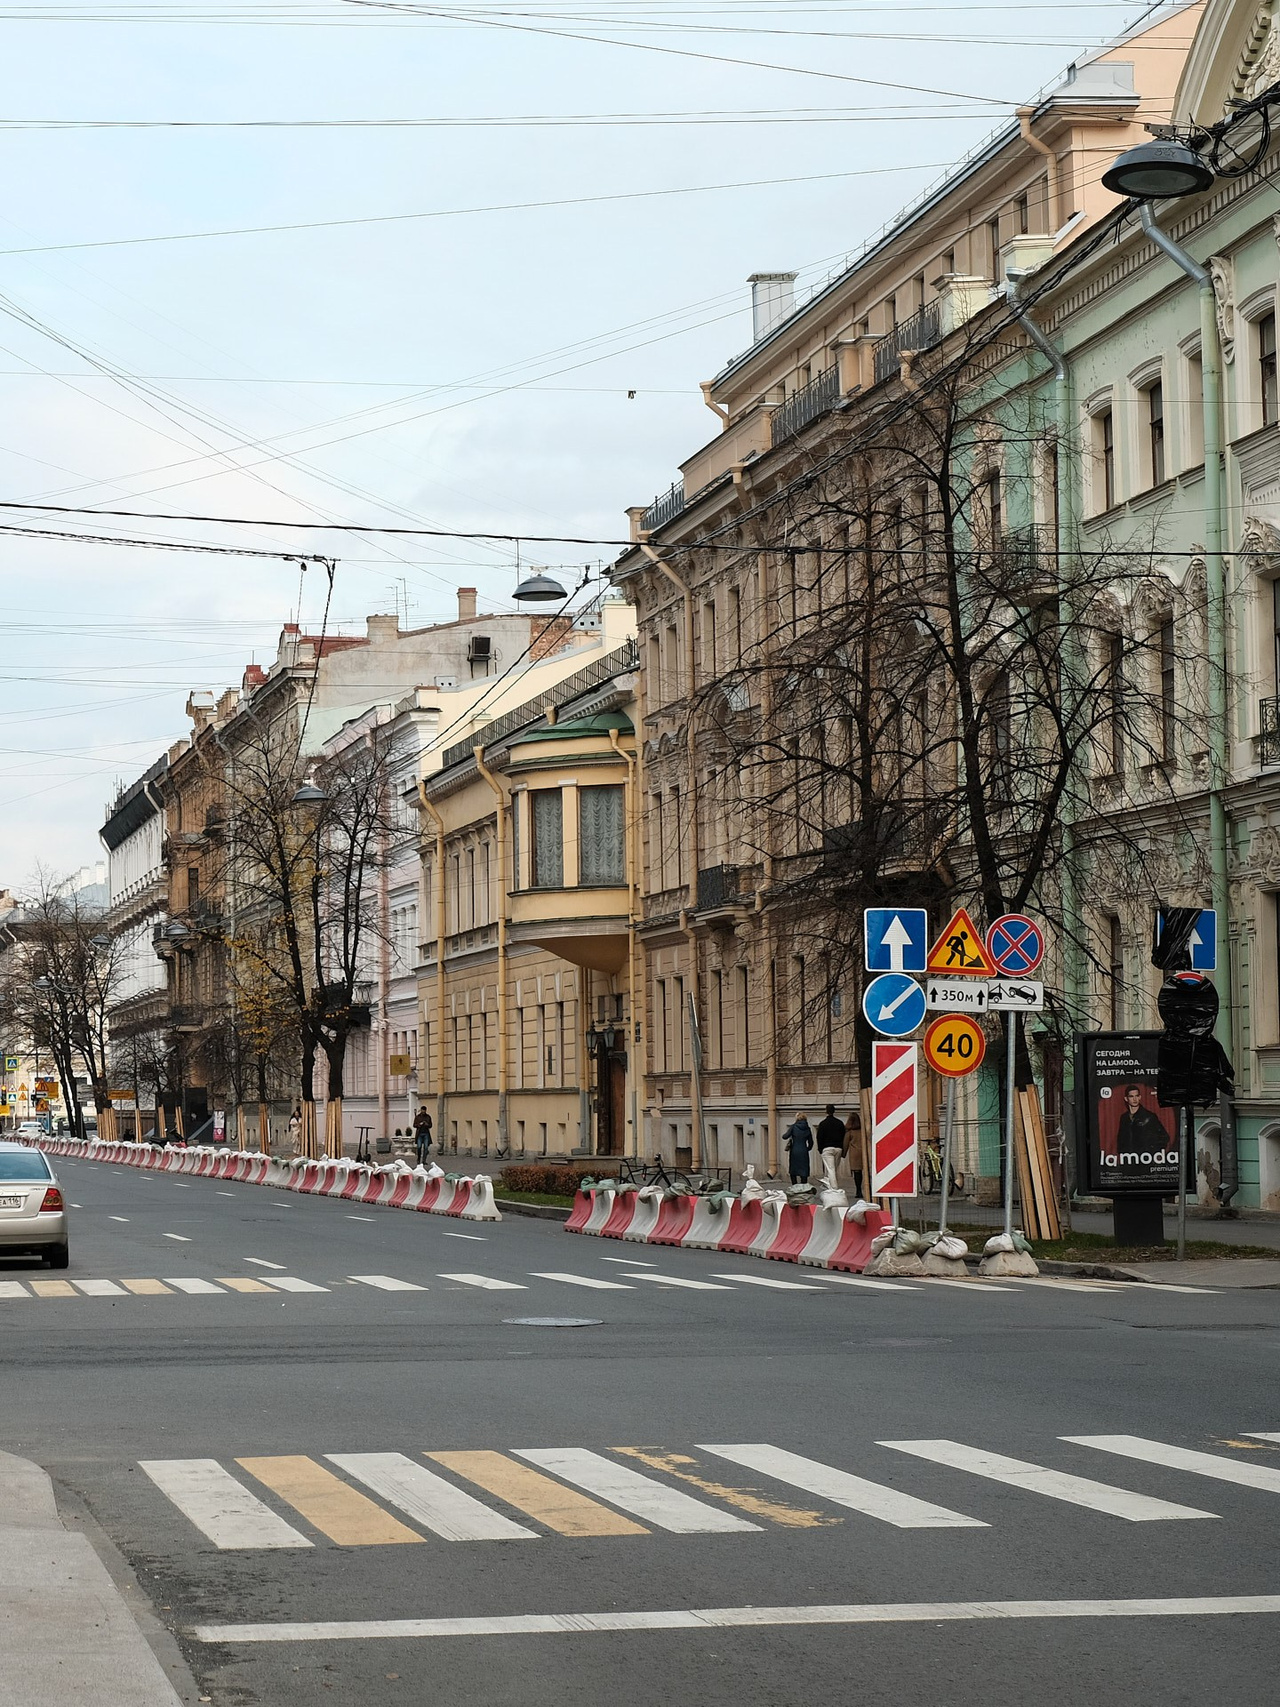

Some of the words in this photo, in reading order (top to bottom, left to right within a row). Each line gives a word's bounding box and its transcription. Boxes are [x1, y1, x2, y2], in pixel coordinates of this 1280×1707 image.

[941, 989, 974, 1002] 350м
[936, 1033, 973, 1058] 40
[1100, 1148, 1179, 1167] lamoda
